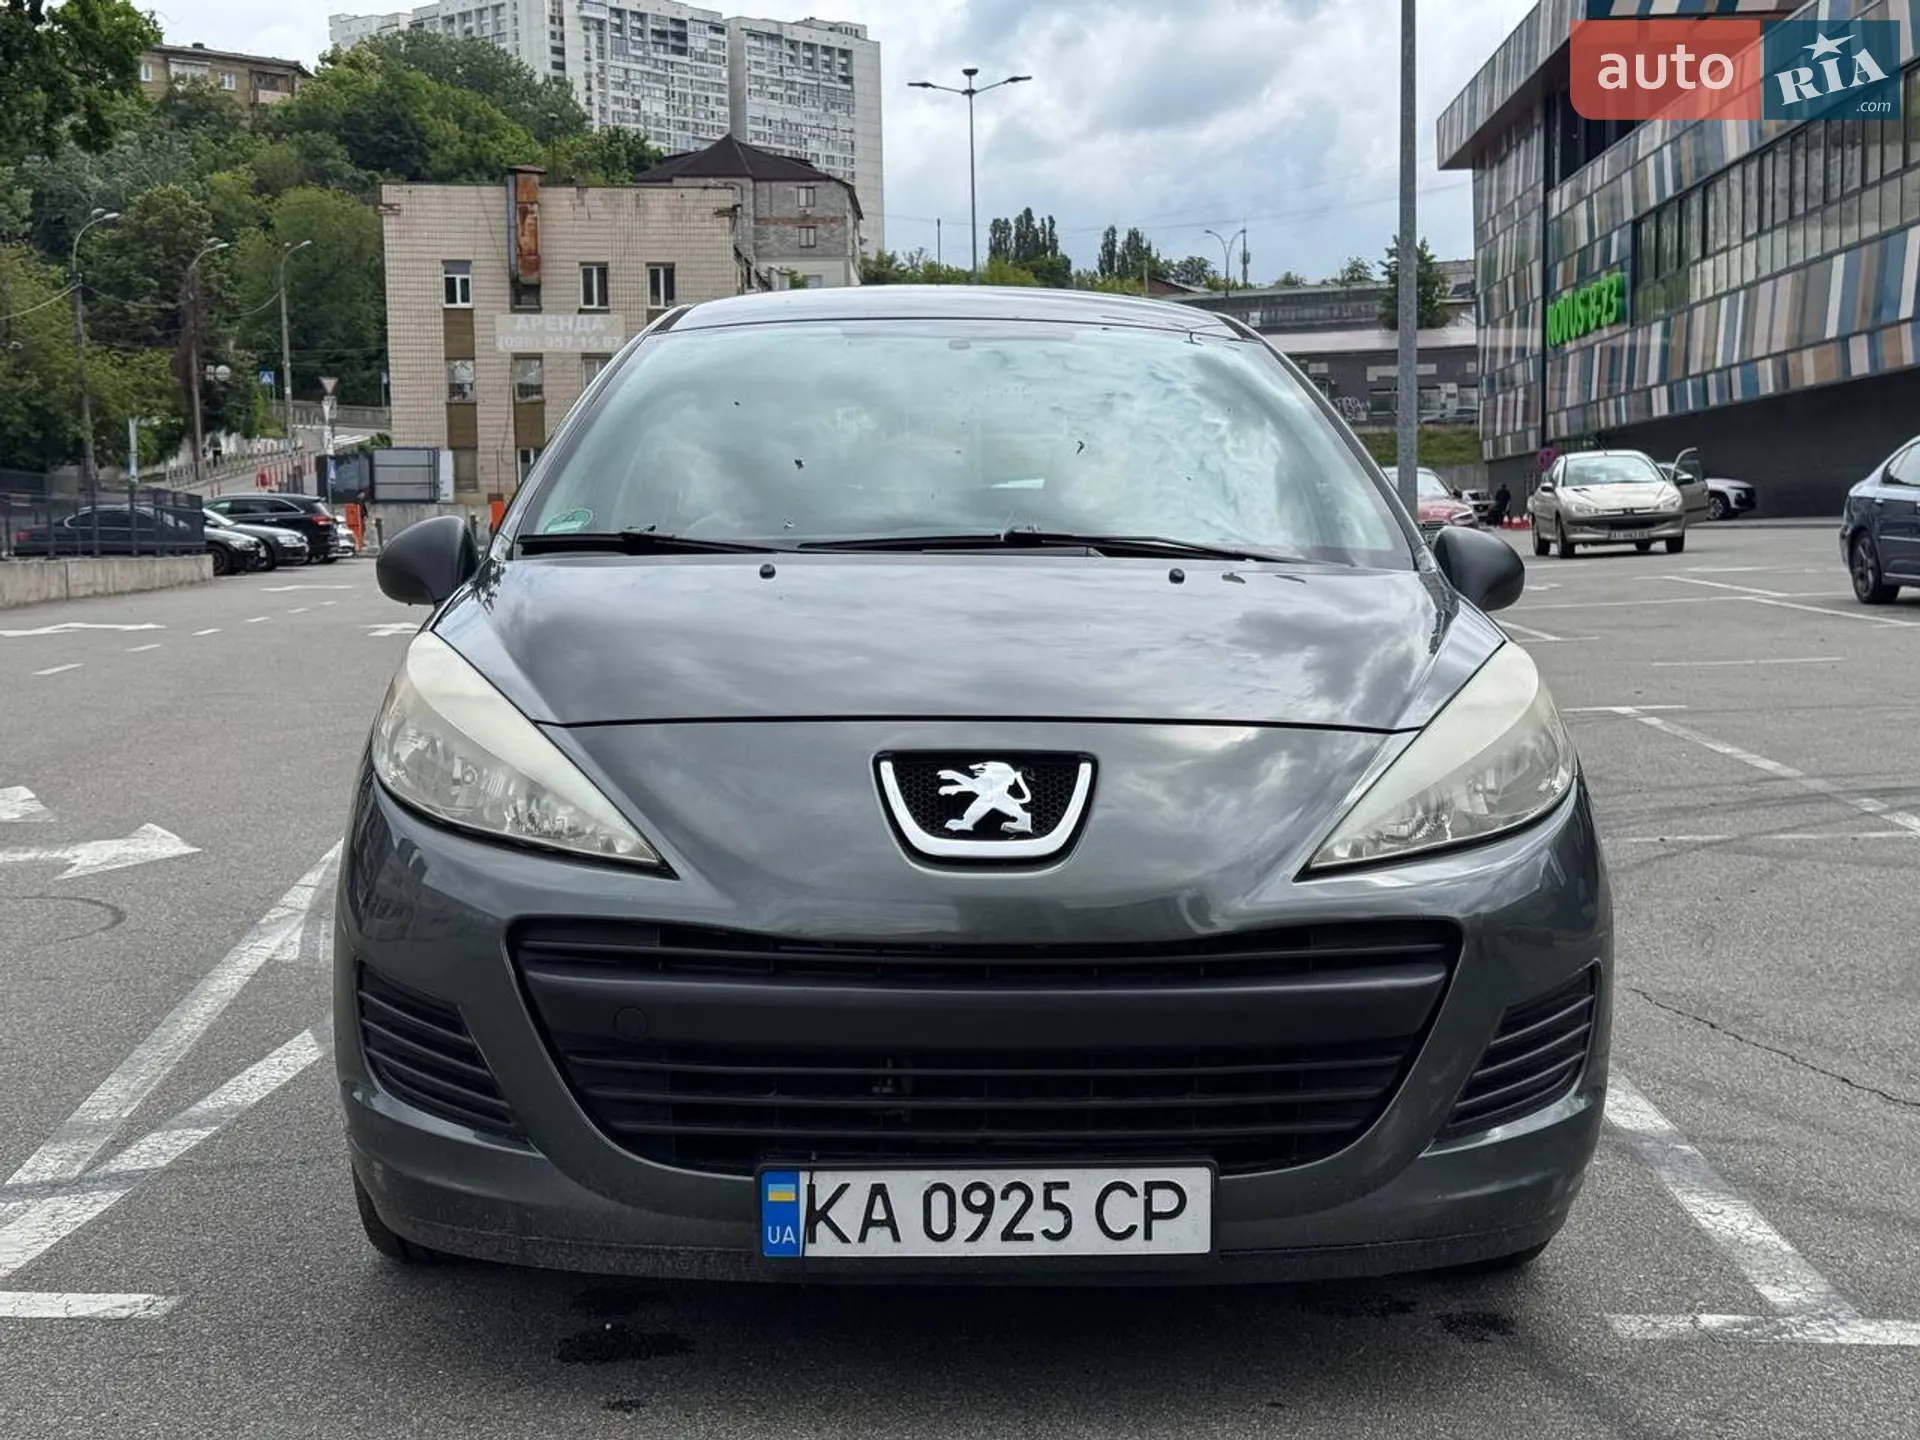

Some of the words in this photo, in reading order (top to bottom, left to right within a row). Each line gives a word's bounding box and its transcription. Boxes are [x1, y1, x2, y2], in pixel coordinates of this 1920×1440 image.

[516, 316, 606, 334] АРЕНДА
[1547, 288, 1585, 349] NOVUS
[807, 1183, 901, 1244] KA
[922, 1181, 1073, 1243] 0925
[1095, 1181, 1187, 1242] CP
[768, 1225, 796, 1244] UA
